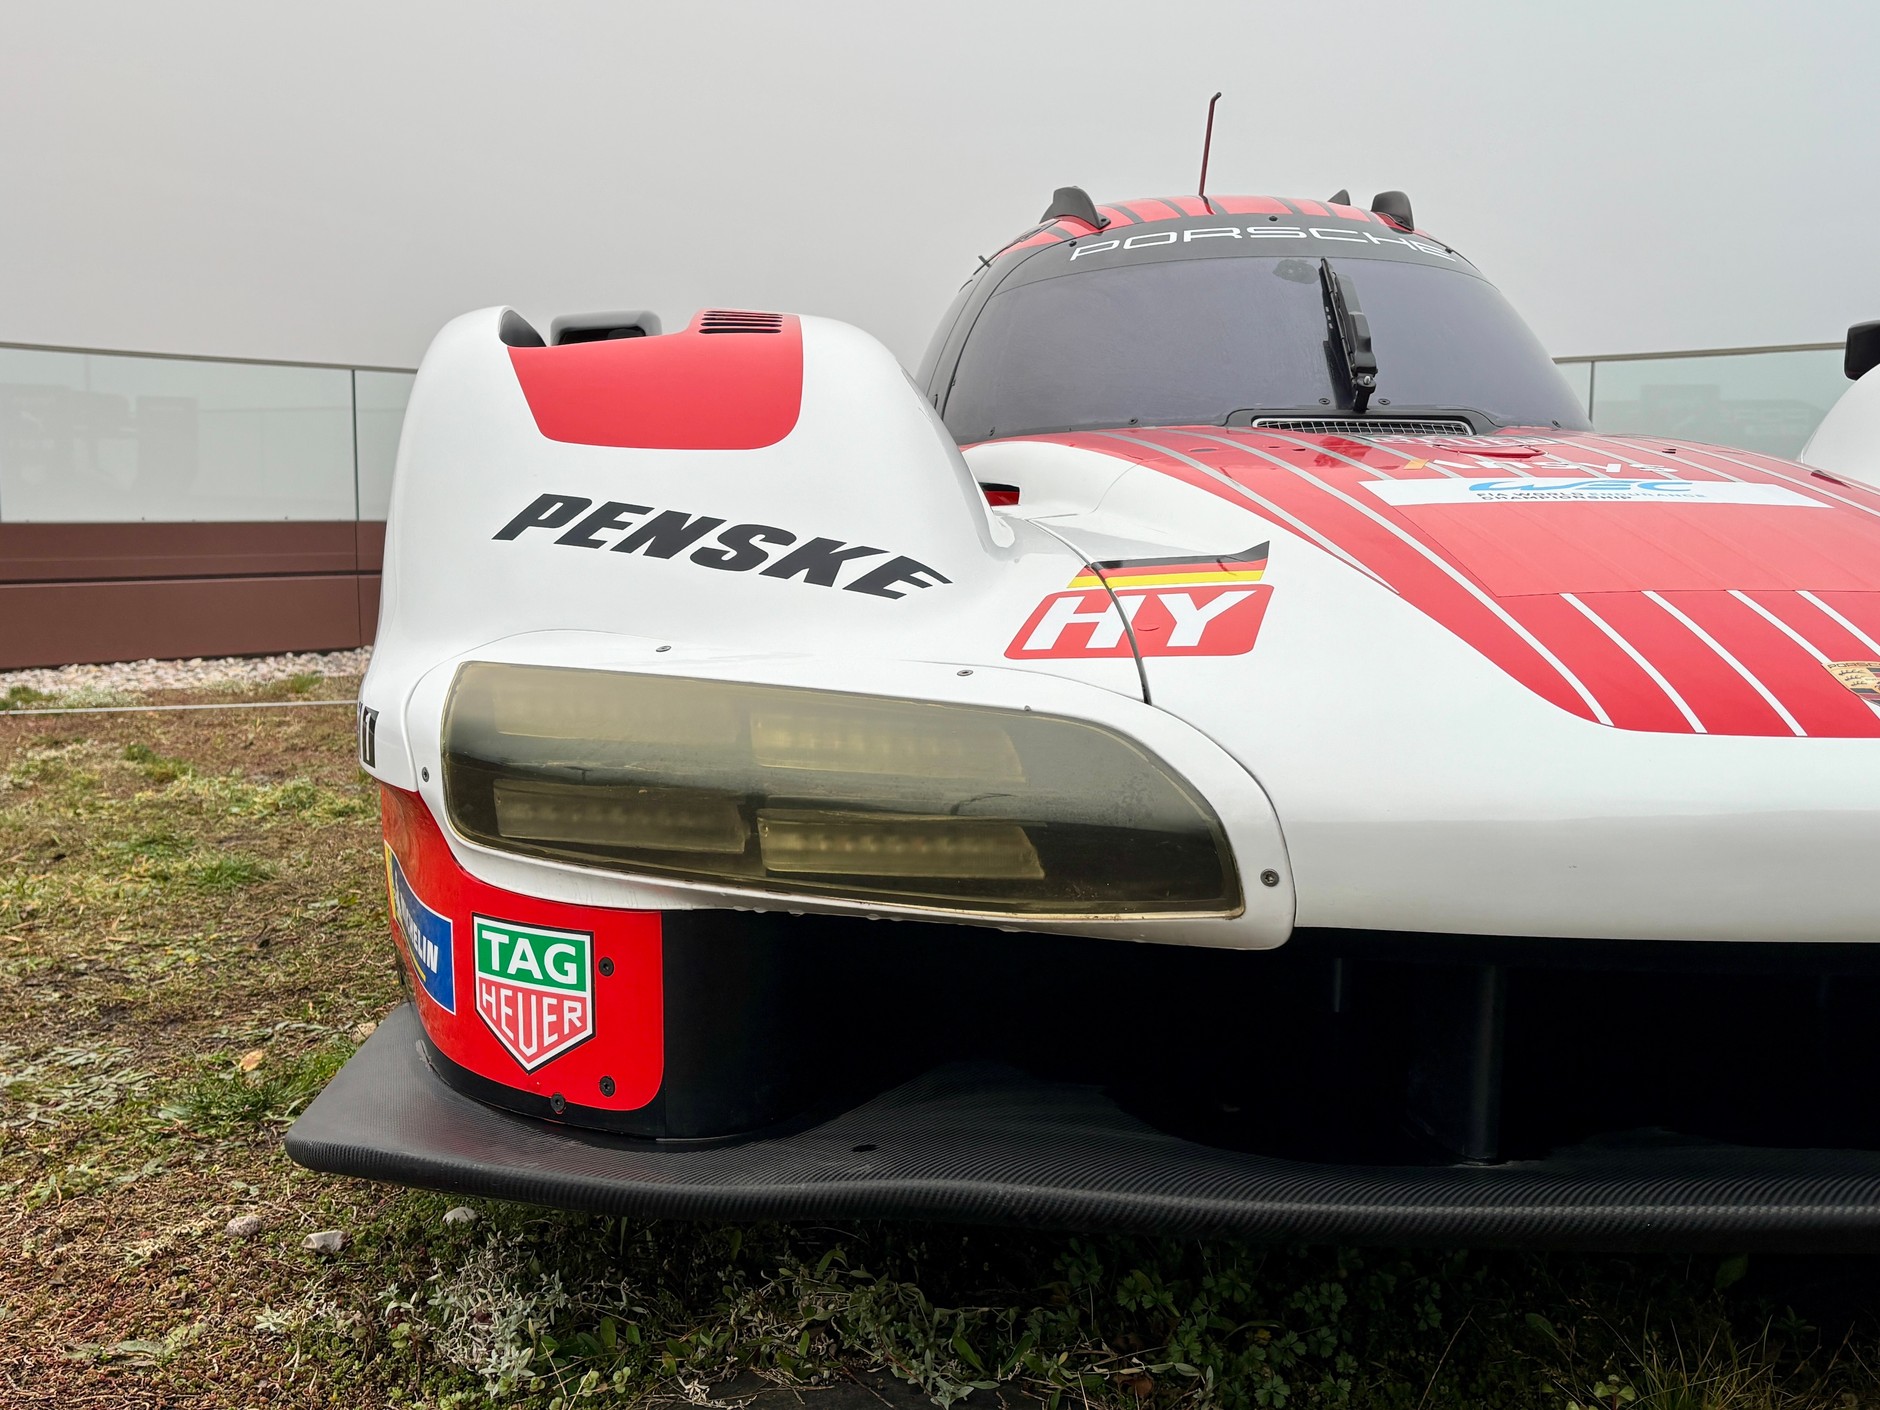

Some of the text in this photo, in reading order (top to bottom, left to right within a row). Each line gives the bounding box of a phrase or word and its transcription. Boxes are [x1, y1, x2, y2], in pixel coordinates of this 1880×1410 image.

[1070, 227, 1456, 262] PORSCHE
[491, 493, 953, 600] PENSKE
[1021, 590, 1258, 650] HY
[482, 929, 577, 985] TAG
[482, 982, 582, 1056] HEUER
